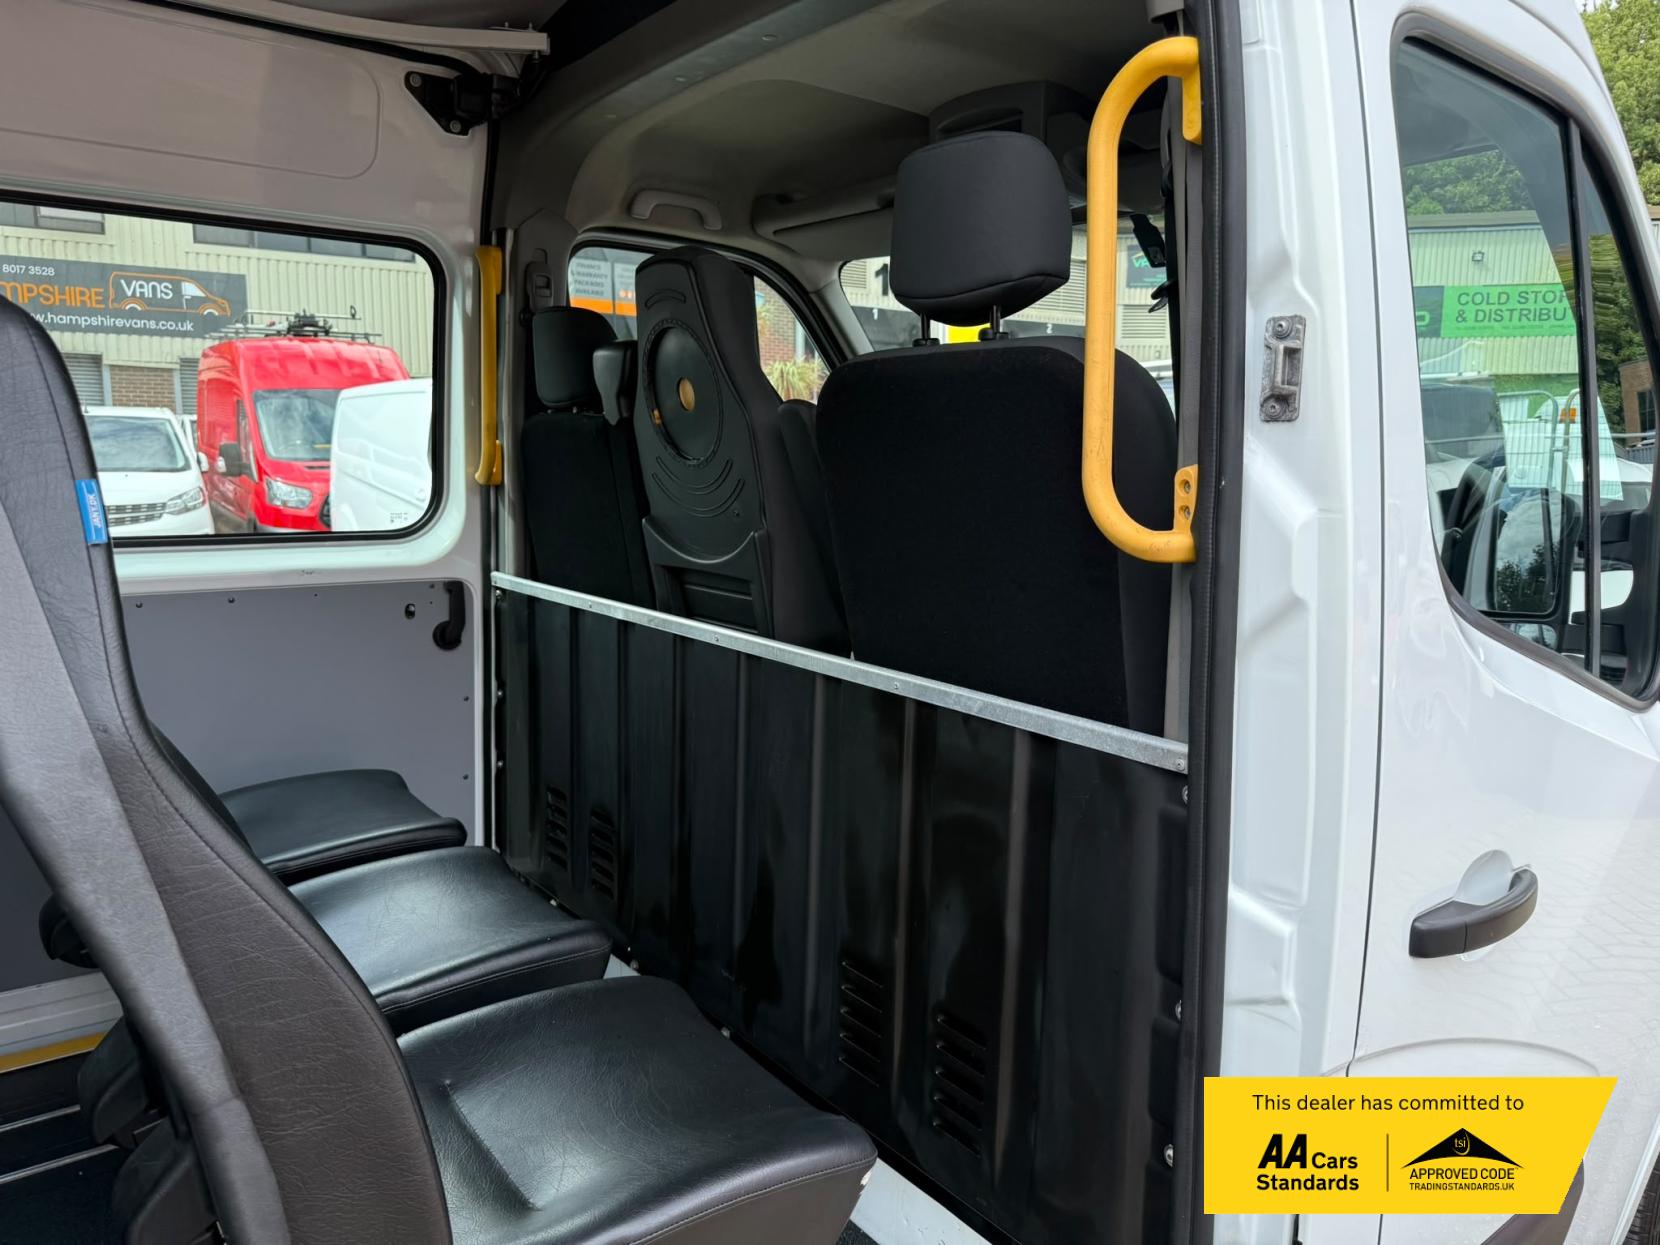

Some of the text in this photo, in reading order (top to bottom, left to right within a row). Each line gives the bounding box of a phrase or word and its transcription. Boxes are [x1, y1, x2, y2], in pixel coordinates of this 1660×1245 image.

[2, 264, 55, 276] 8017 3528
[120, 279, 173, 300] VANS
[874, 263, 889, 297] 1
[1457, 291, 1510, 306] COLD
[30, 311, 194, 332] w.hampshirevans.co.uk
[1455, 306, 1571, 323] & DISTRIBU
